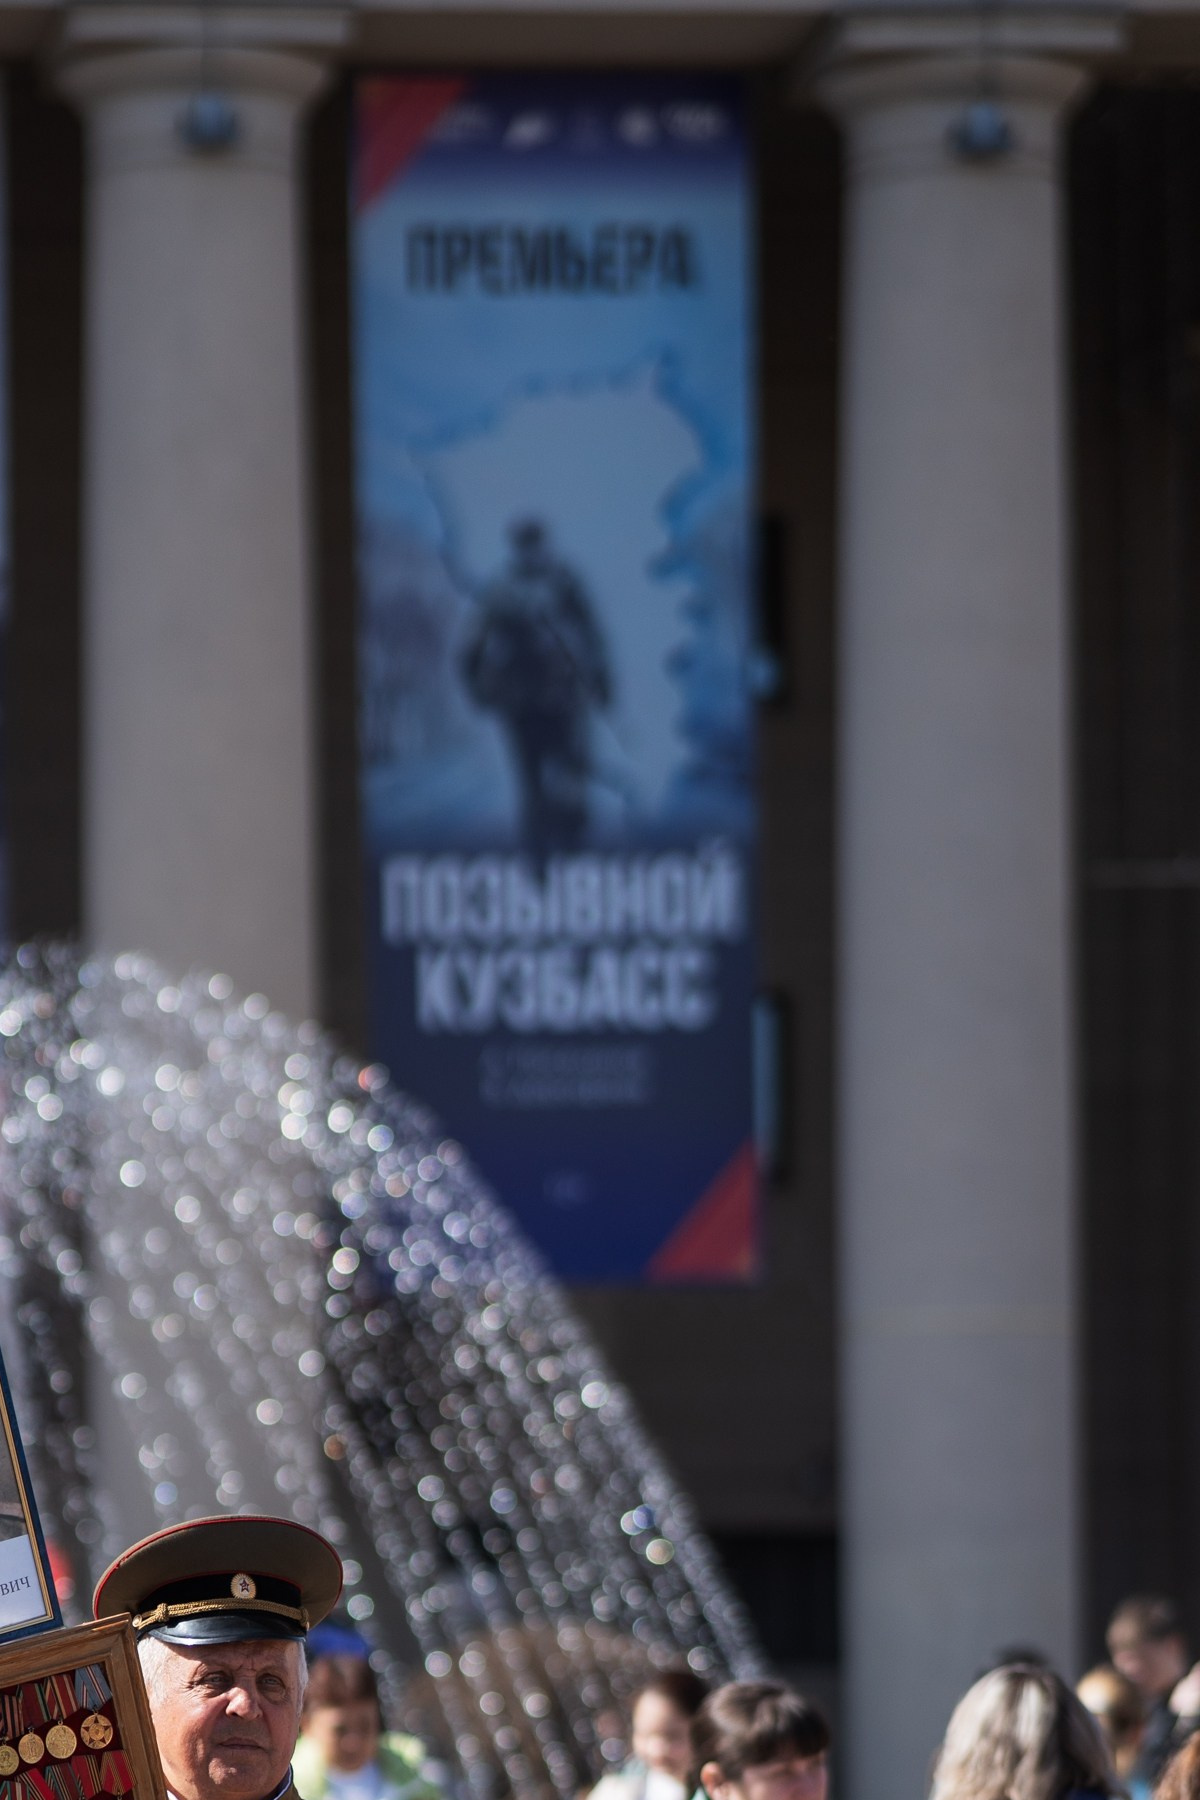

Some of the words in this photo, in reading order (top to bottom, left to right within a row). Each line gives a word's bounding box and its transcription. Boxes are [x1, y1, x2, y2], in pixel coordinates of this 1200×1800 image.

[406, 222, 694, 295] ПРЕМЬЕРА
[382, 842, 744, 944] ПОЗЫВНОЙ
[416, 945, 712, 1034] КУЗБАСС
